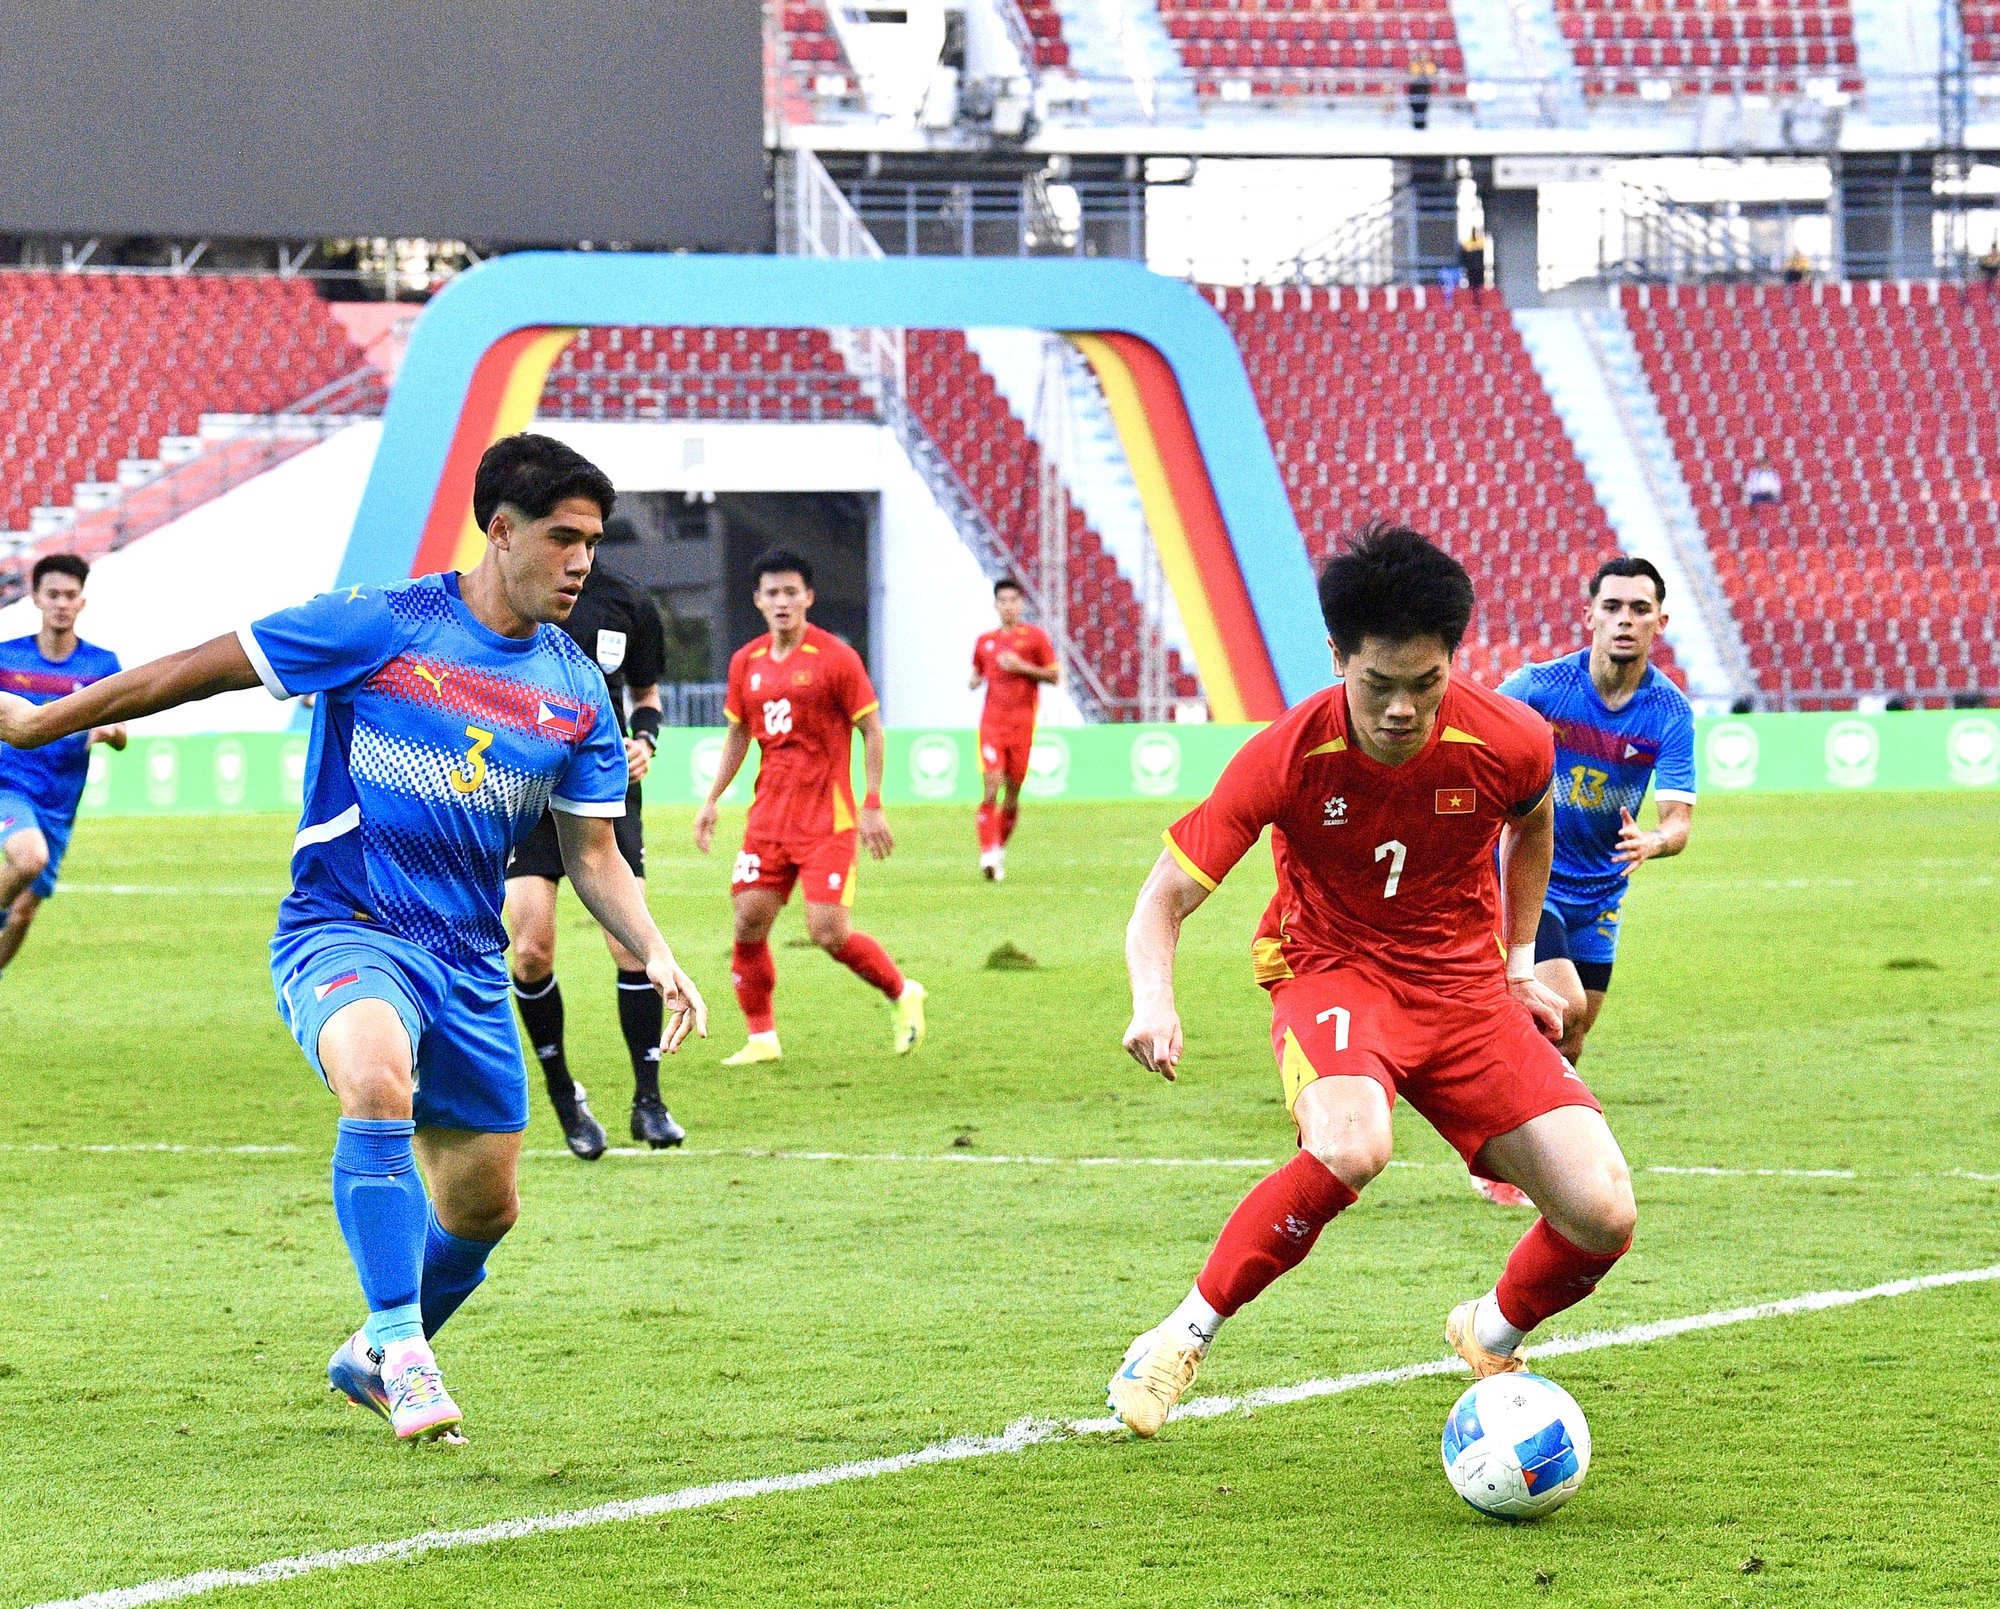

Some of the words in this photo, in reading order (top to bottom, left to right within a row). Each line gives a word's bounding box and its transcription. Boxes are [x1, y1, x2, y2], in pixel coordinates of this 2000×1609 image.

[762, 698, 792, 735] 22
[450, 724, 494, 793] 3
[1569, 765, 1609, 808] 13
[1375, 839, 1407, 899] 7
[1316, 1006, 1350, 1052] 7
